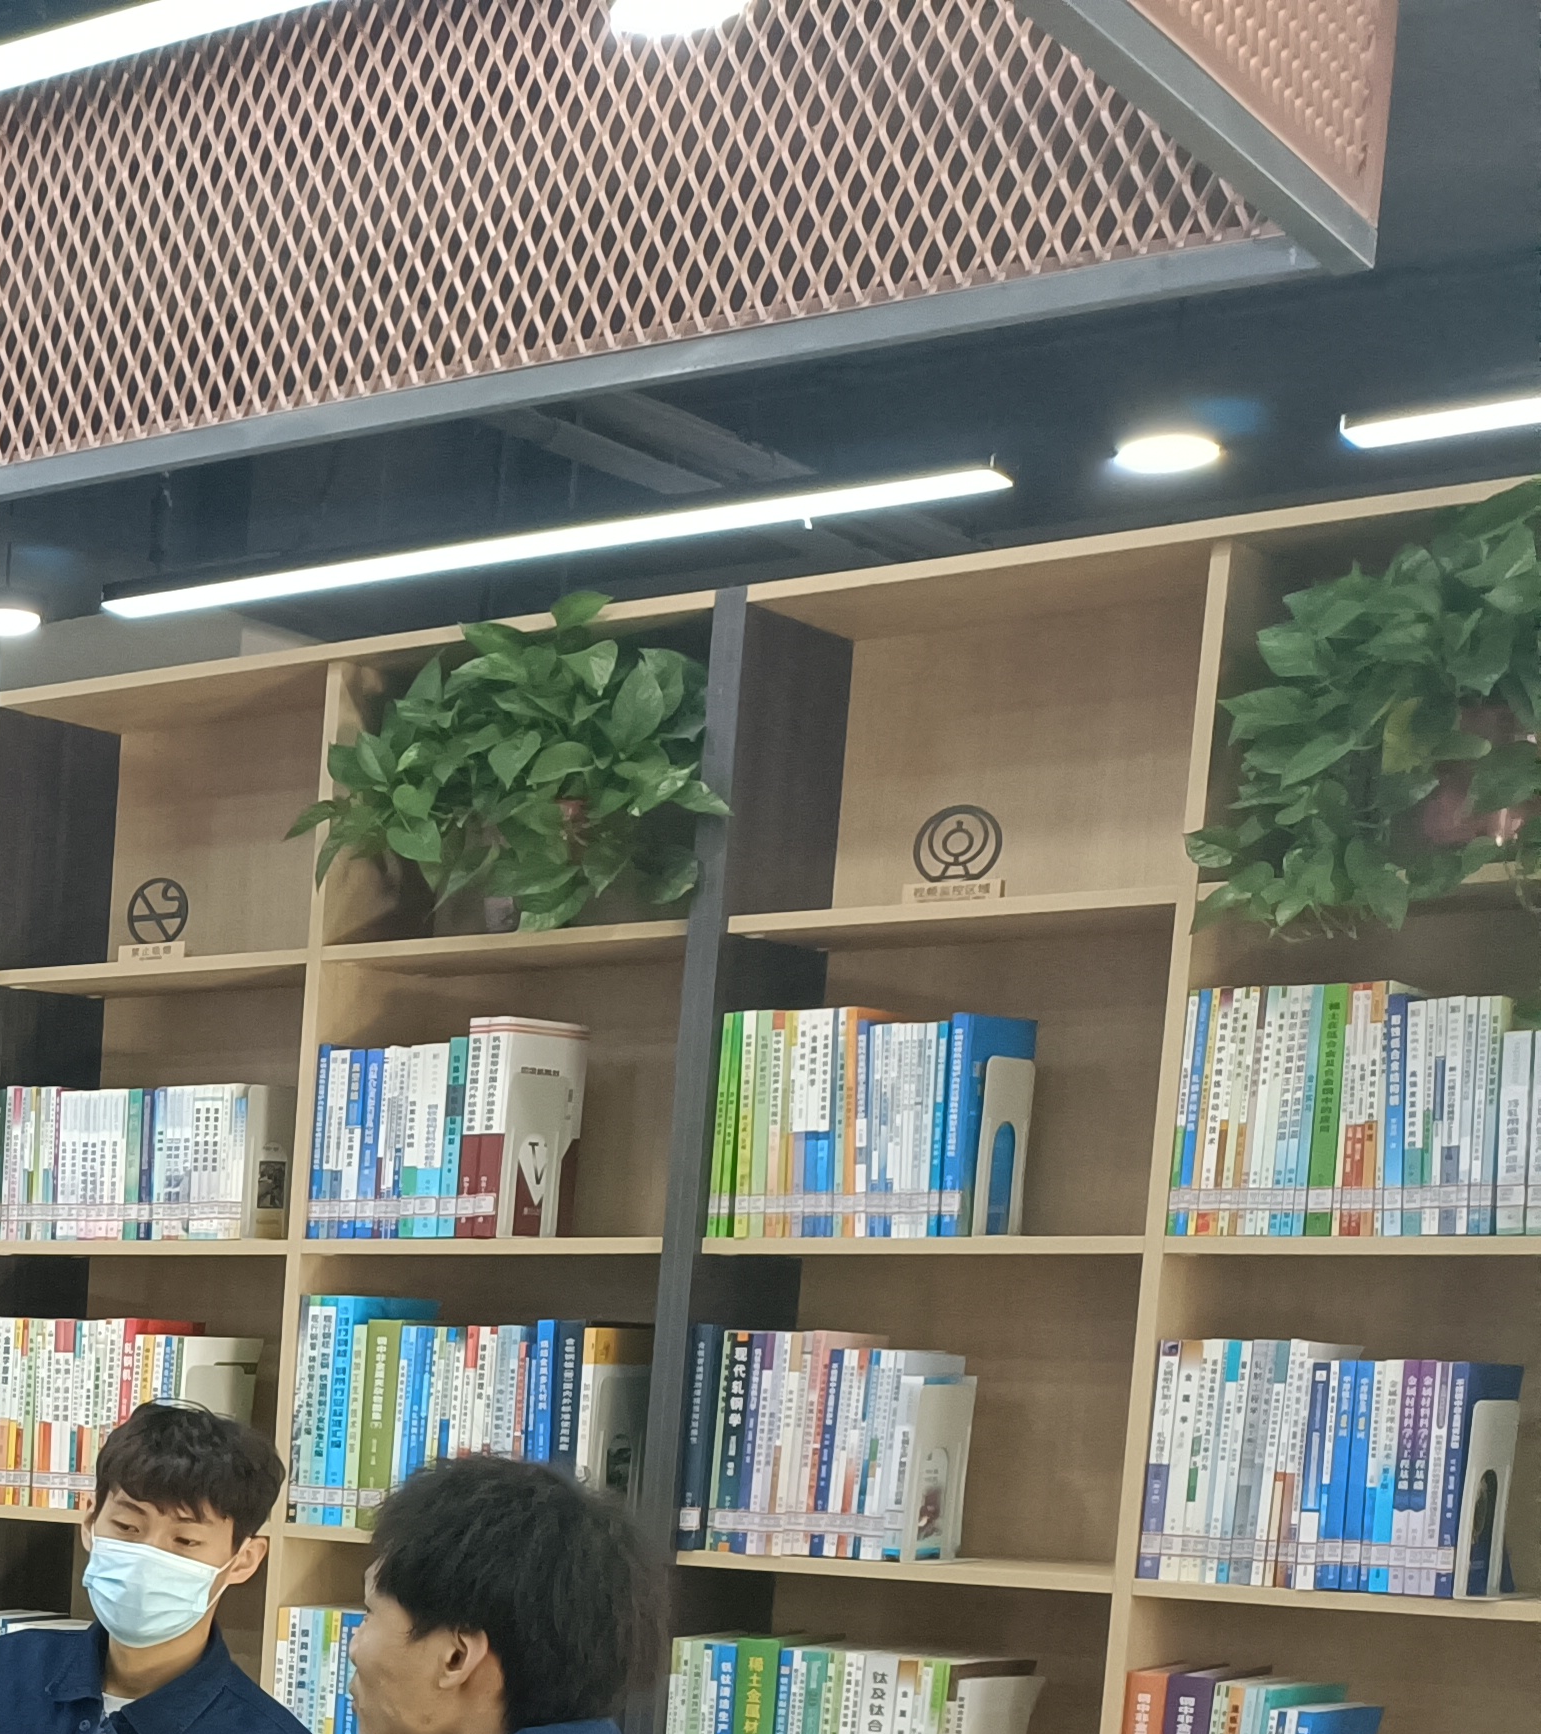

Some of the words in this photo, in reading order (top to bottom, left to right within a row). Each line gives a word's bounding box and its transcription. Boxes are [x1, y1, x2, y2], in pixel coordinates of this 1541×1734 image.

[728, 1346, 748, 1428] 现代轧钢学
